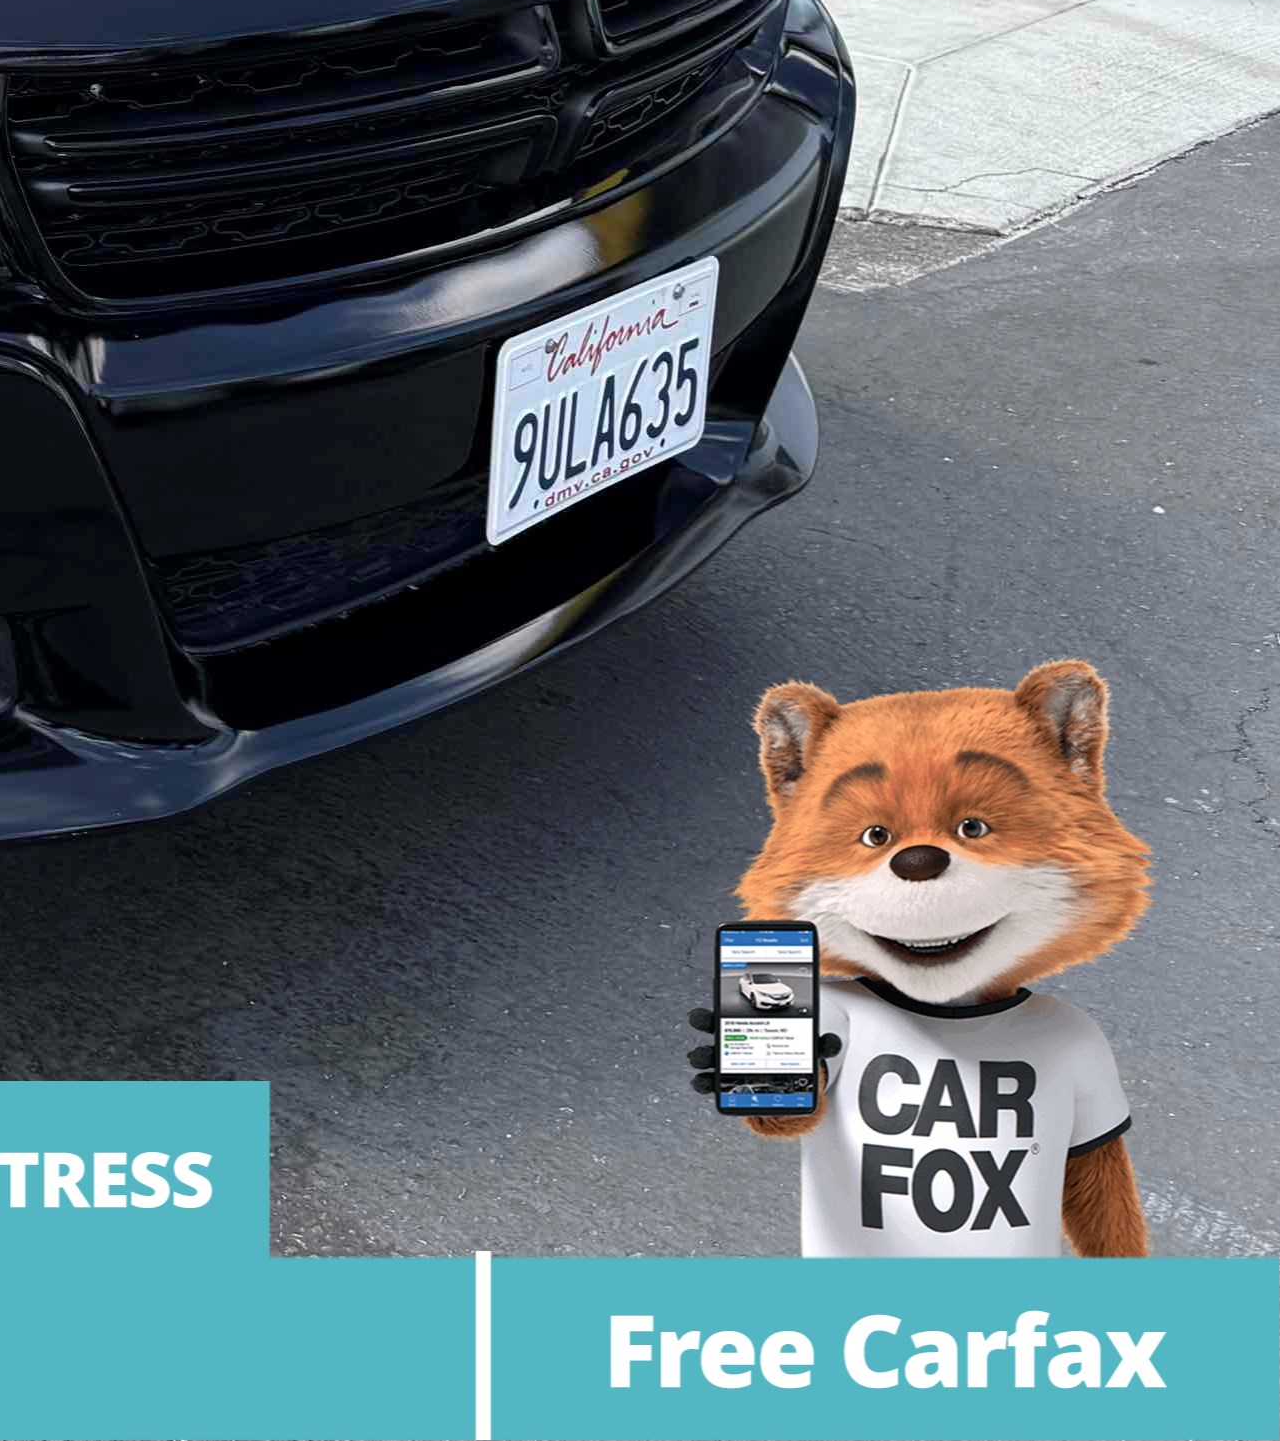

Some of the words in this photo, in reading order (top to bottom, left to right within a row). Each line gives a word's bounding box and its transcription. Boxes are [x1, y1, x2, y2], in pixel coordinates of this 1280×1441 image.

[547, 308, 678, 382] California
[509, 337, 700, 510] 9ULA635
[545, 446, 654, 508] dmv.ca.gov
